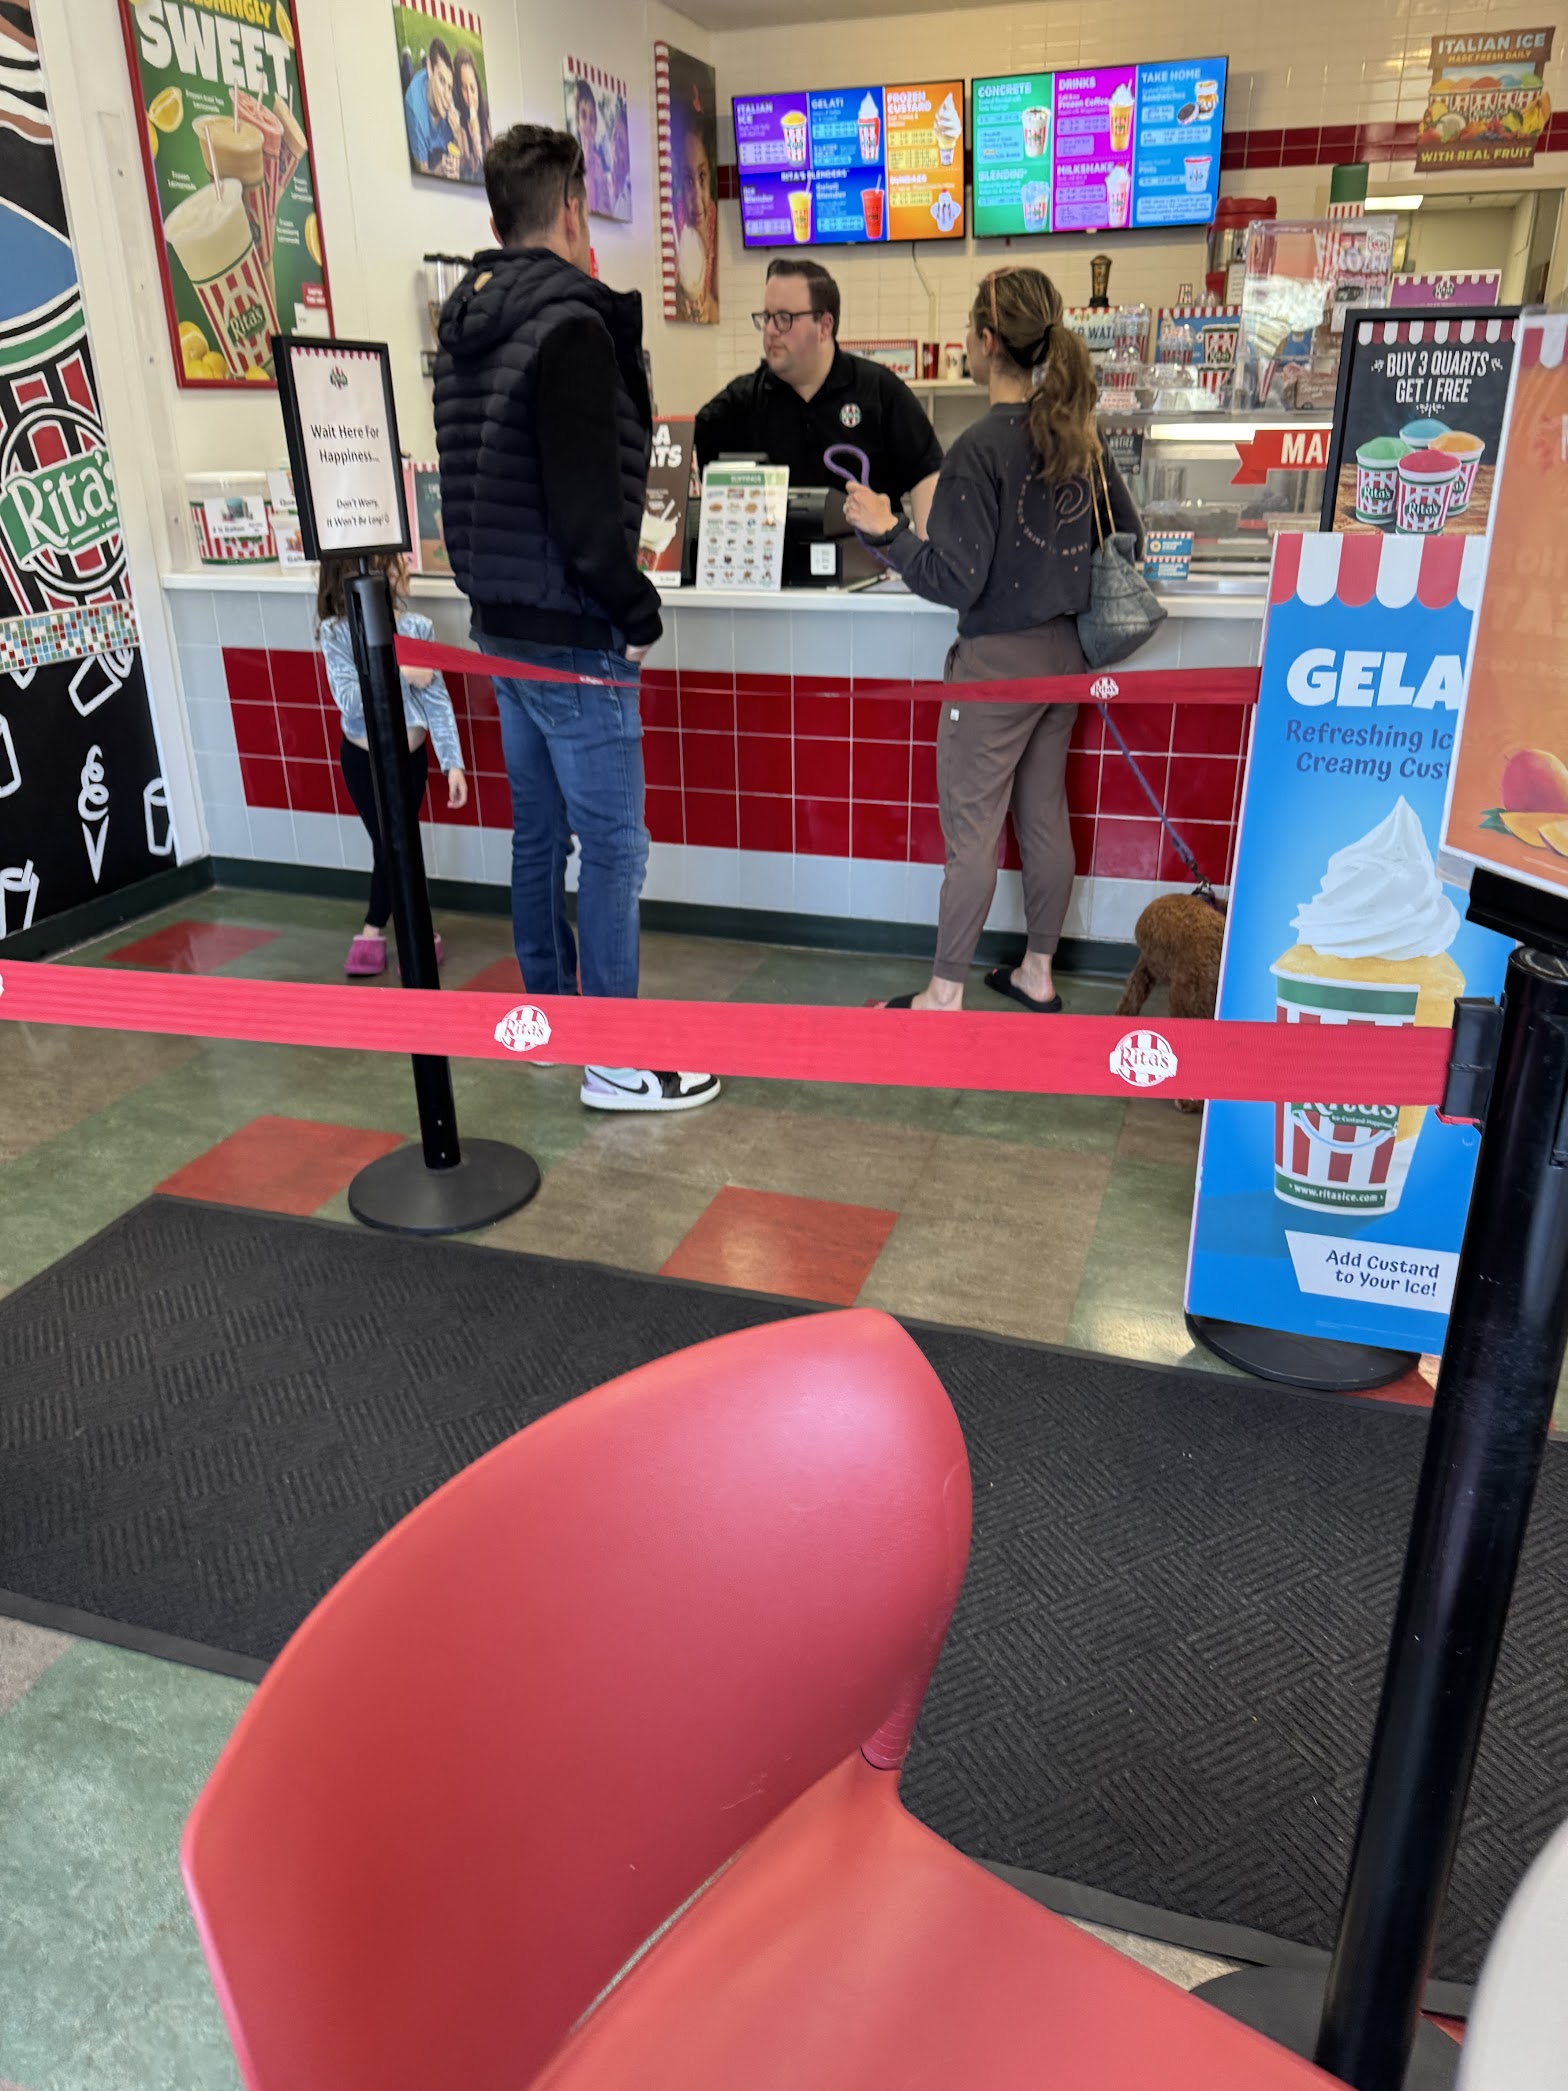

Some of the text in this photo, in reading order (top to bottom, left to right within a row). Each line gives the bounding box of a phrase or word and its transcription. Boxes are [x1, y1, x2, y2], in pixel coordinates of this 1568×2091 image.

[134, 0, 291, 99] SWEET
[1438, 33, 1546, 54] ITALIAN ICE
[1448, 54, 1473, 63] MADE
[1505, 50, 1531, 60] DAILY
[1058, 76, 1096, 91] DRINKS
[1141, 67, 1201, 84] TAKE HOME
[978, 82, 1032, 98] CONCRETE
[736, 102, 773, 114] ITALIAN
[811, 98, 844, 110] GELATI
[1421, 147, 1532, 163] WITH REAL FRUIT
[1386, 351, 1490, 377] BUY 3 QUARTS
[1395, 378, 1425, 403] GET
[1434, 378, 1472, 403] FREE
[310, 424, 379, 439] Wait Here For
[319, 447, 380, 466] Happiness...
[1286, 648, 1464, 711] GELA
[1286, 719, 1424, 754] Refreshing
[1296, 751, 1392, 783] Creamy
[1294, 1183, 1378, 1203] www.ritasice.com
[1326, 1250, 1440, 1279] Add Custard
[1335, 1269, 1437, 1297] to Your Ice!
